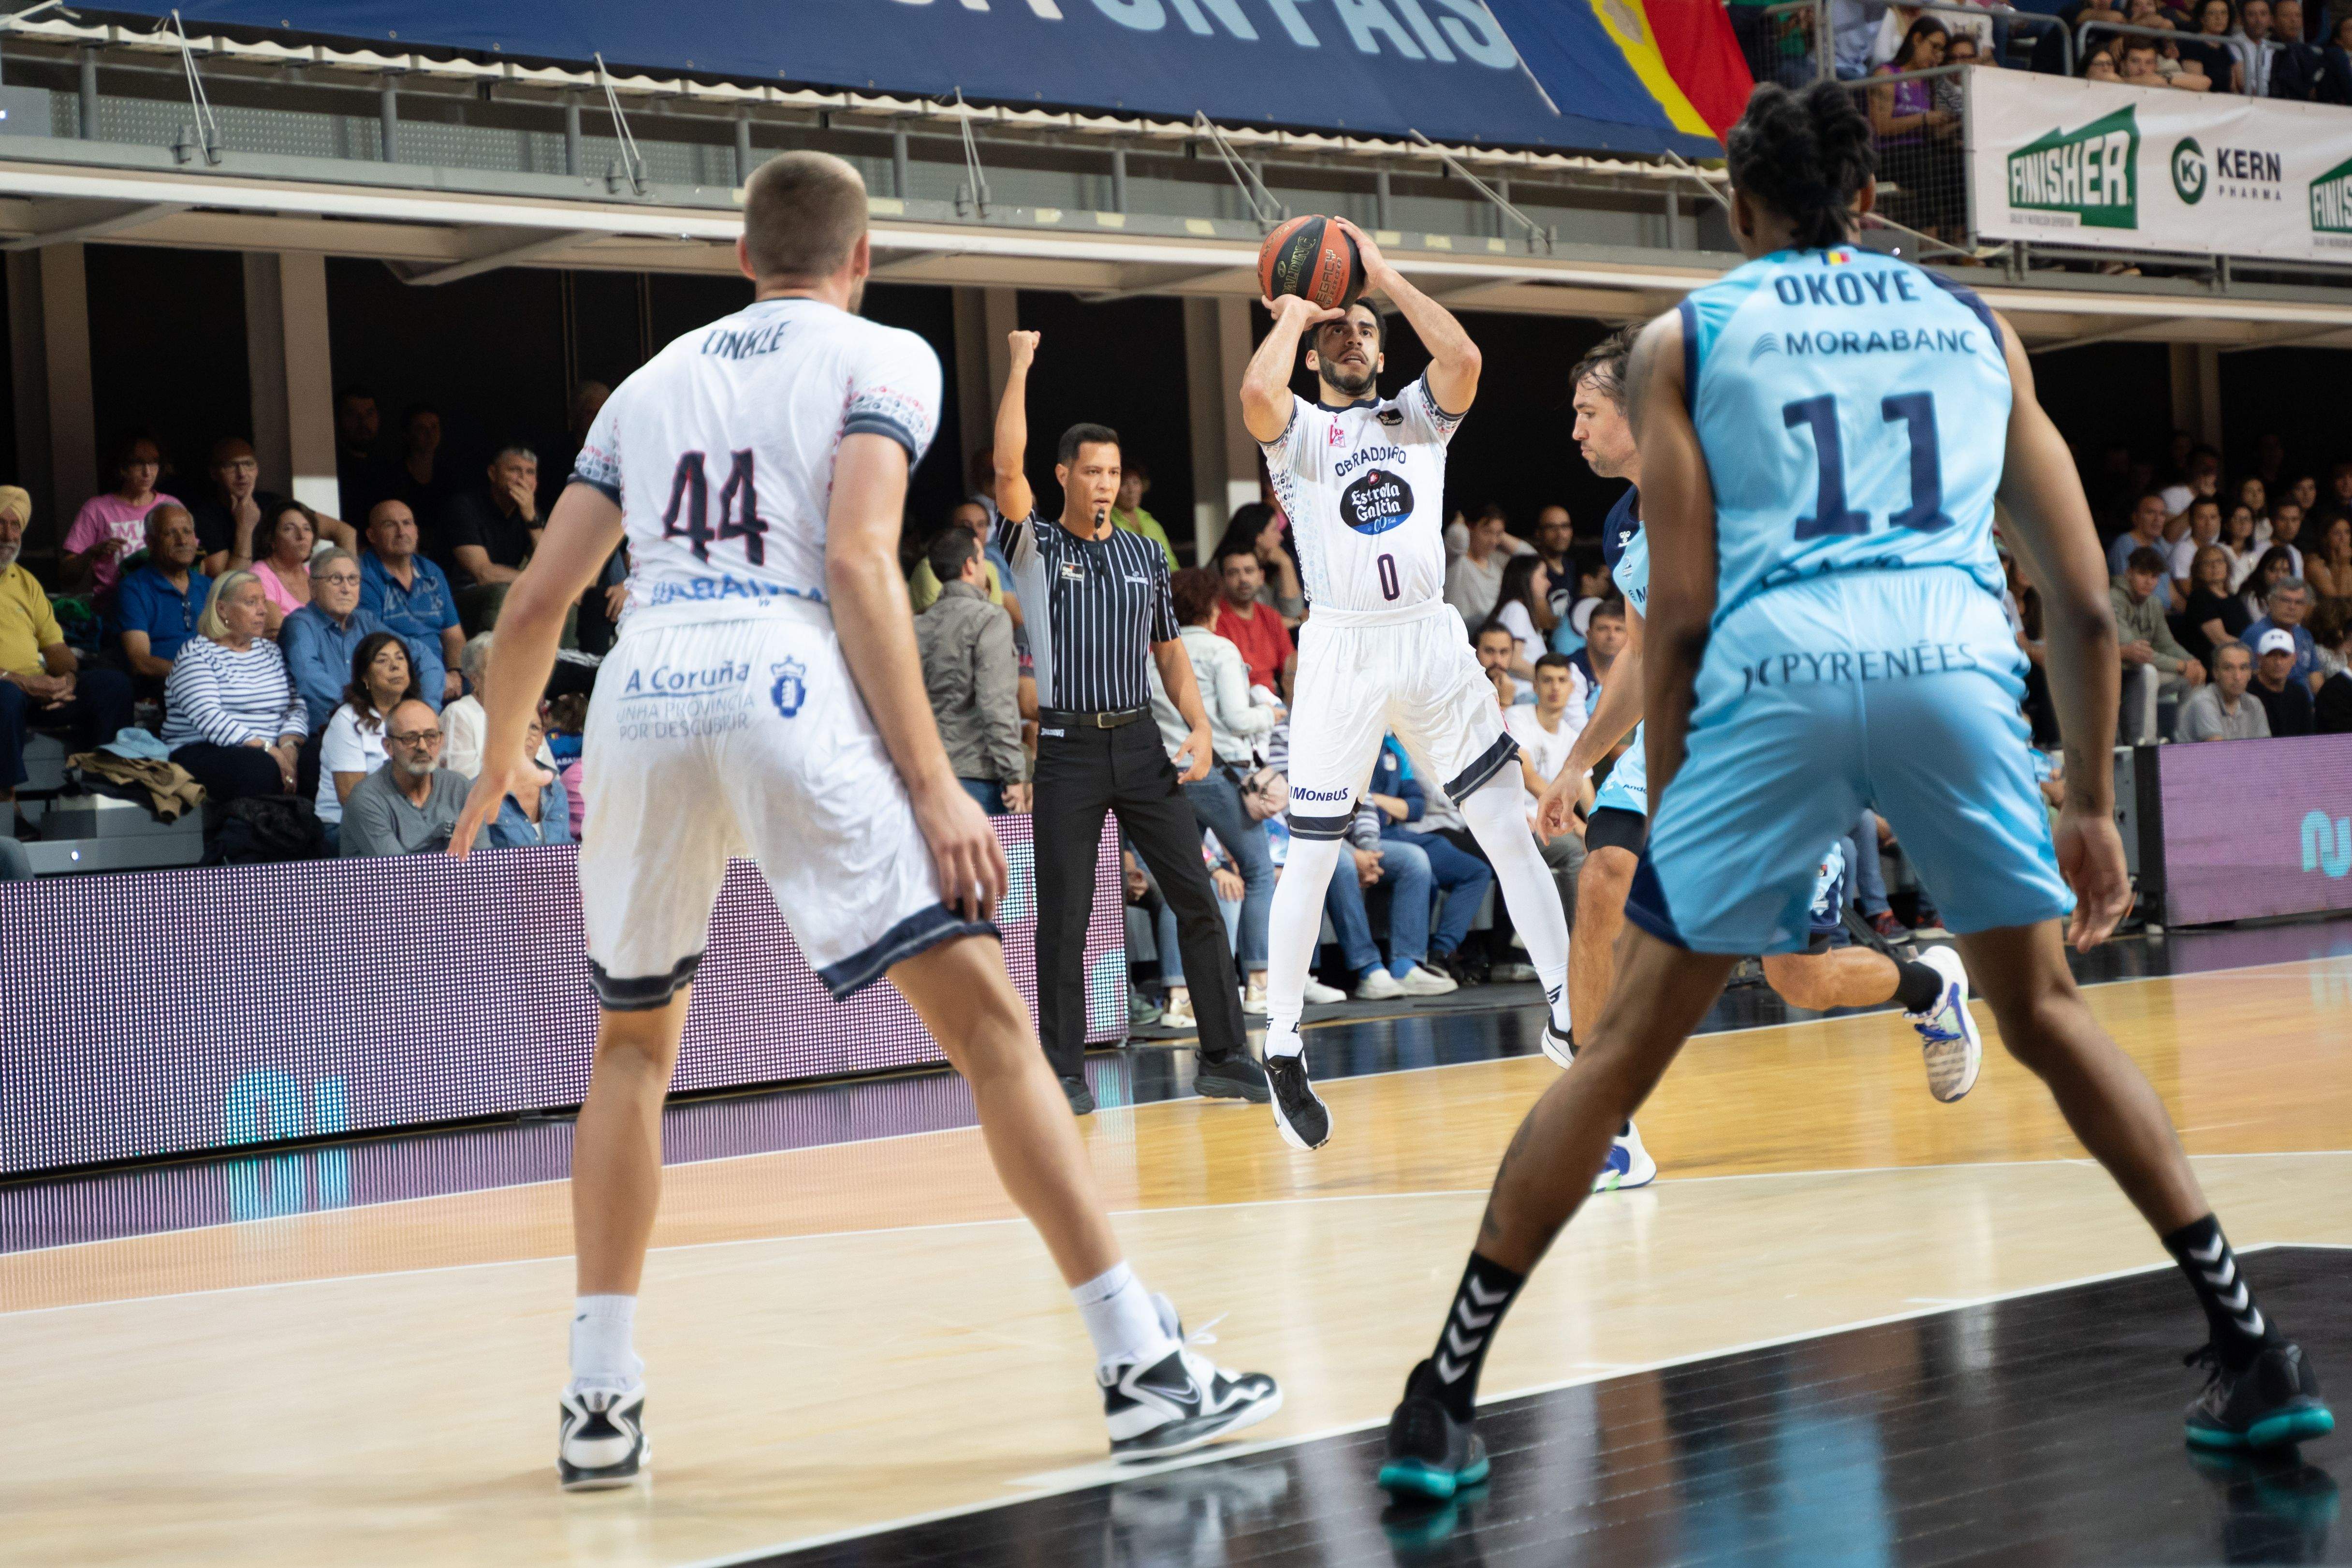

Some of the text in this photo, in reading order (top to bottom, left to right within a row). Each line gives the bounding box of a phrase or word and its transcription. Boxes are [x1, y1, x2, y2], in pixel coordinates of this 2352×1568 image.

[2011, 129, 2129, 206] FINISHER
[2217, 147, 2282, 182] KERN
[2219, 184, 2282, 201] PHARMA
[1282, 235, 1316, 294] PALDING
[1314, 248, 1336, 303] EGACY
[1774, 269, 1921, 306] OKOYE
[1786, 328, 1976, 356] MORABANC
[1335, 446, 1406, 477] OBRADOIRO
[1782, 390, 1956, 540] 11
[663, 447, 769, 566] 44
[1377, 553, 1401, 601] 0
[625, 660, 750, 693] A Coruña
[619, 722, 649, 742] POR
